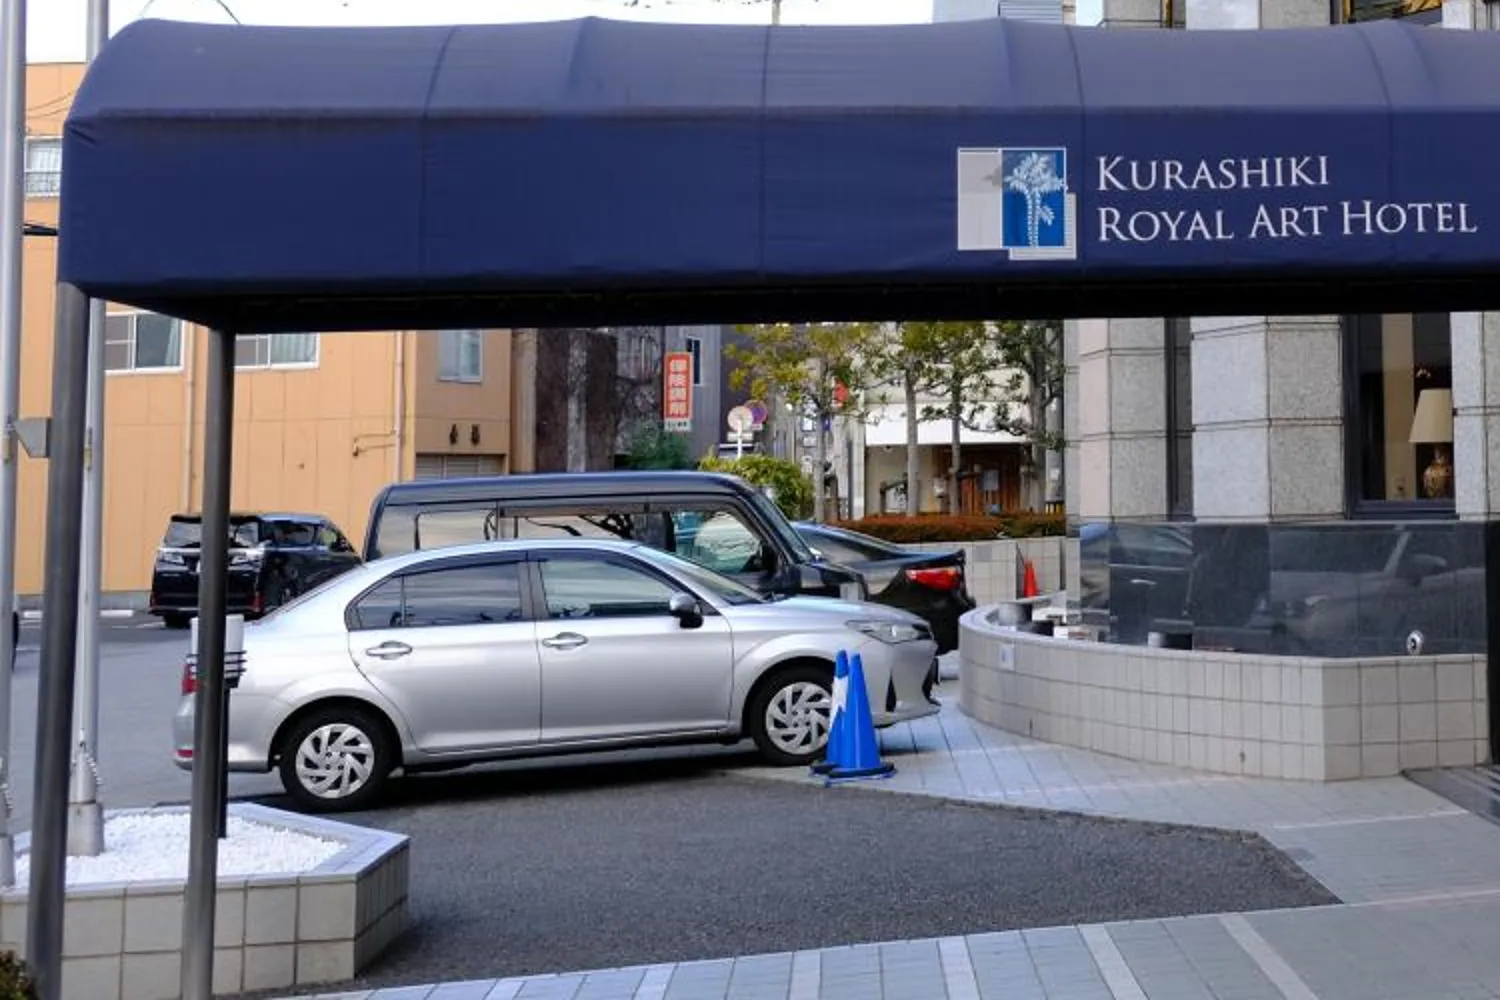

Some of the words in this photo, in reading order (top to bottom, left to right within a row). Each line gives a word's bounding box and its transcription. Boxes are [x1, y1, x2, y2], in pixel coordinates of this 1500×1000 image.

[1099, 156, 1328, 190] KURASHIKI
[1098, 207, 1234, 241] ROYAL
[1250, 205, 1328, 238] ART
[1342, 200, 1477, 234] HOTEL
